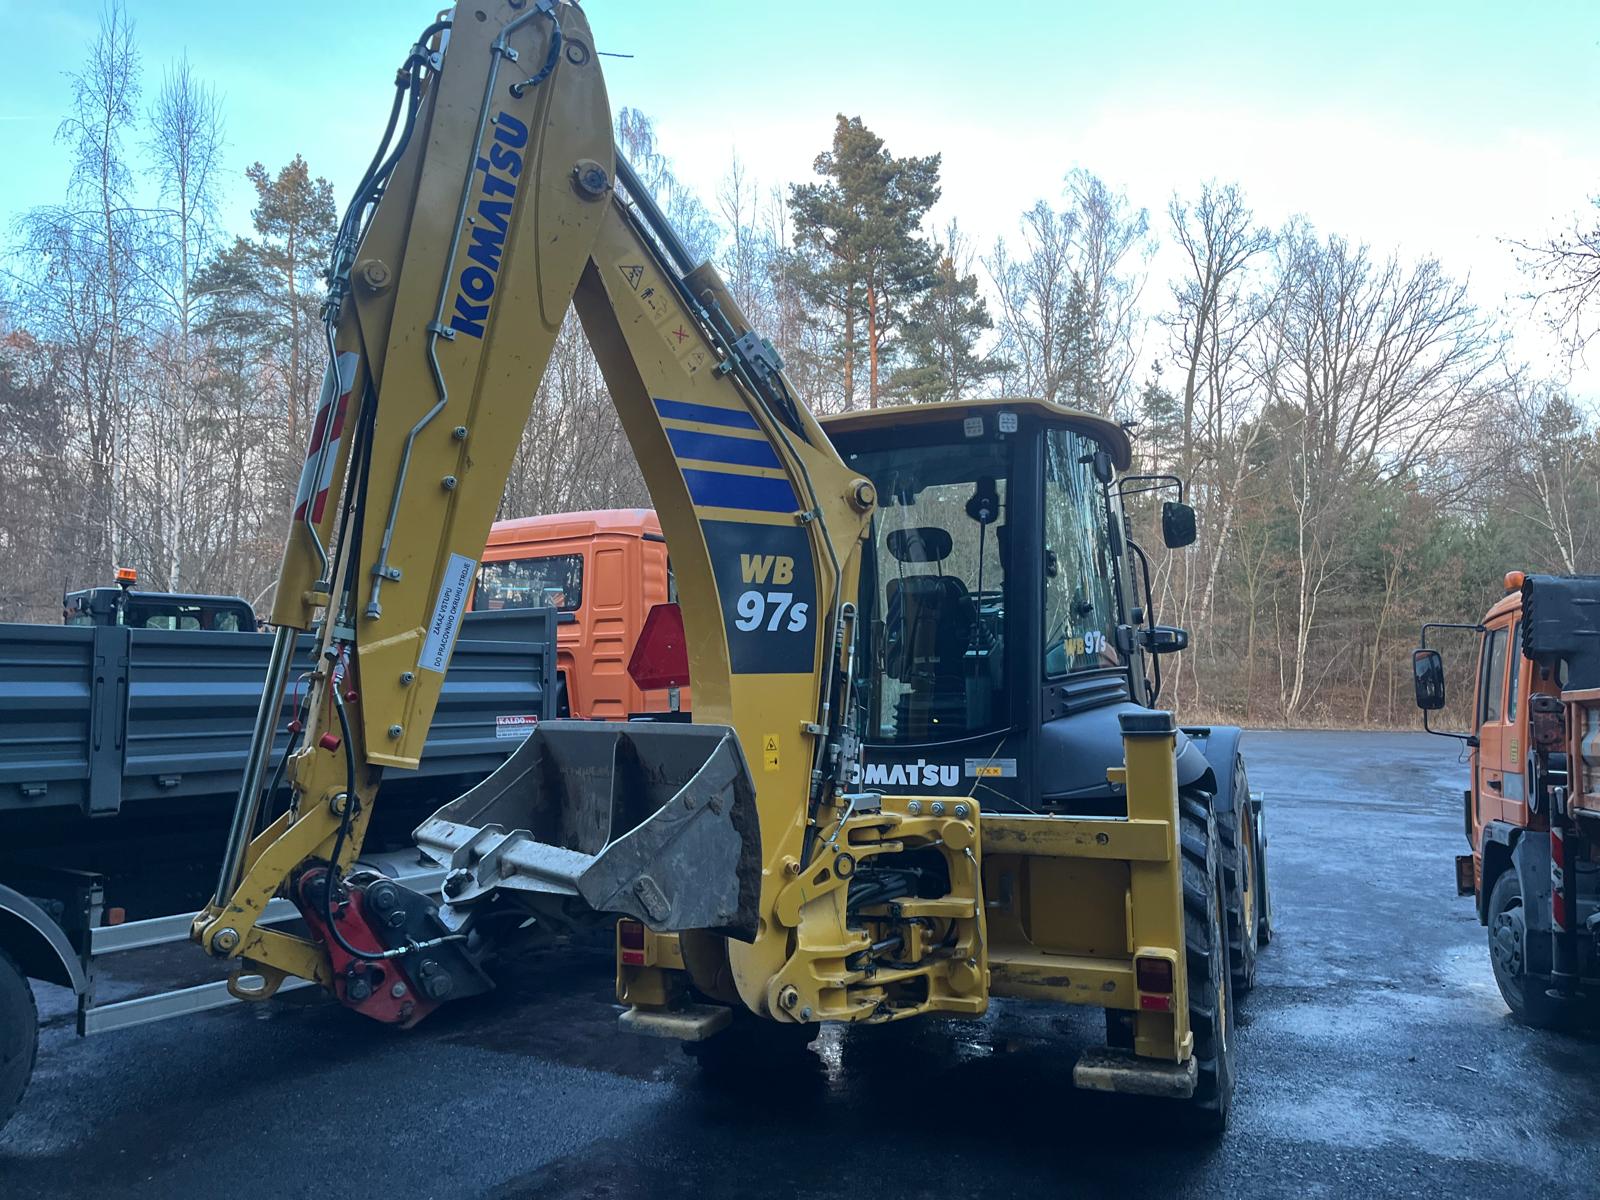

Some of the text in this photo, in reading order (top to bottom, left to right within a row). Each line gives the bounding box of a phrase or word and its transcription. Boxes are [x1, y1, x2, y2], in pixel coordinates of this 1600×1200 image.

[450, 111, 528, 339] KOMATSU
[740, 553, 795, 585] WB
[440, 587, 453, 613] VSTUPU
[450, 587, 463, 614] OKRUHU
[458, 562, 471, 587] STROJE
[735, 590, 809, 632] 97s
[1064, 630, 1106, 656] WB 97s
[848, 758, 960, 787] OMATSU
